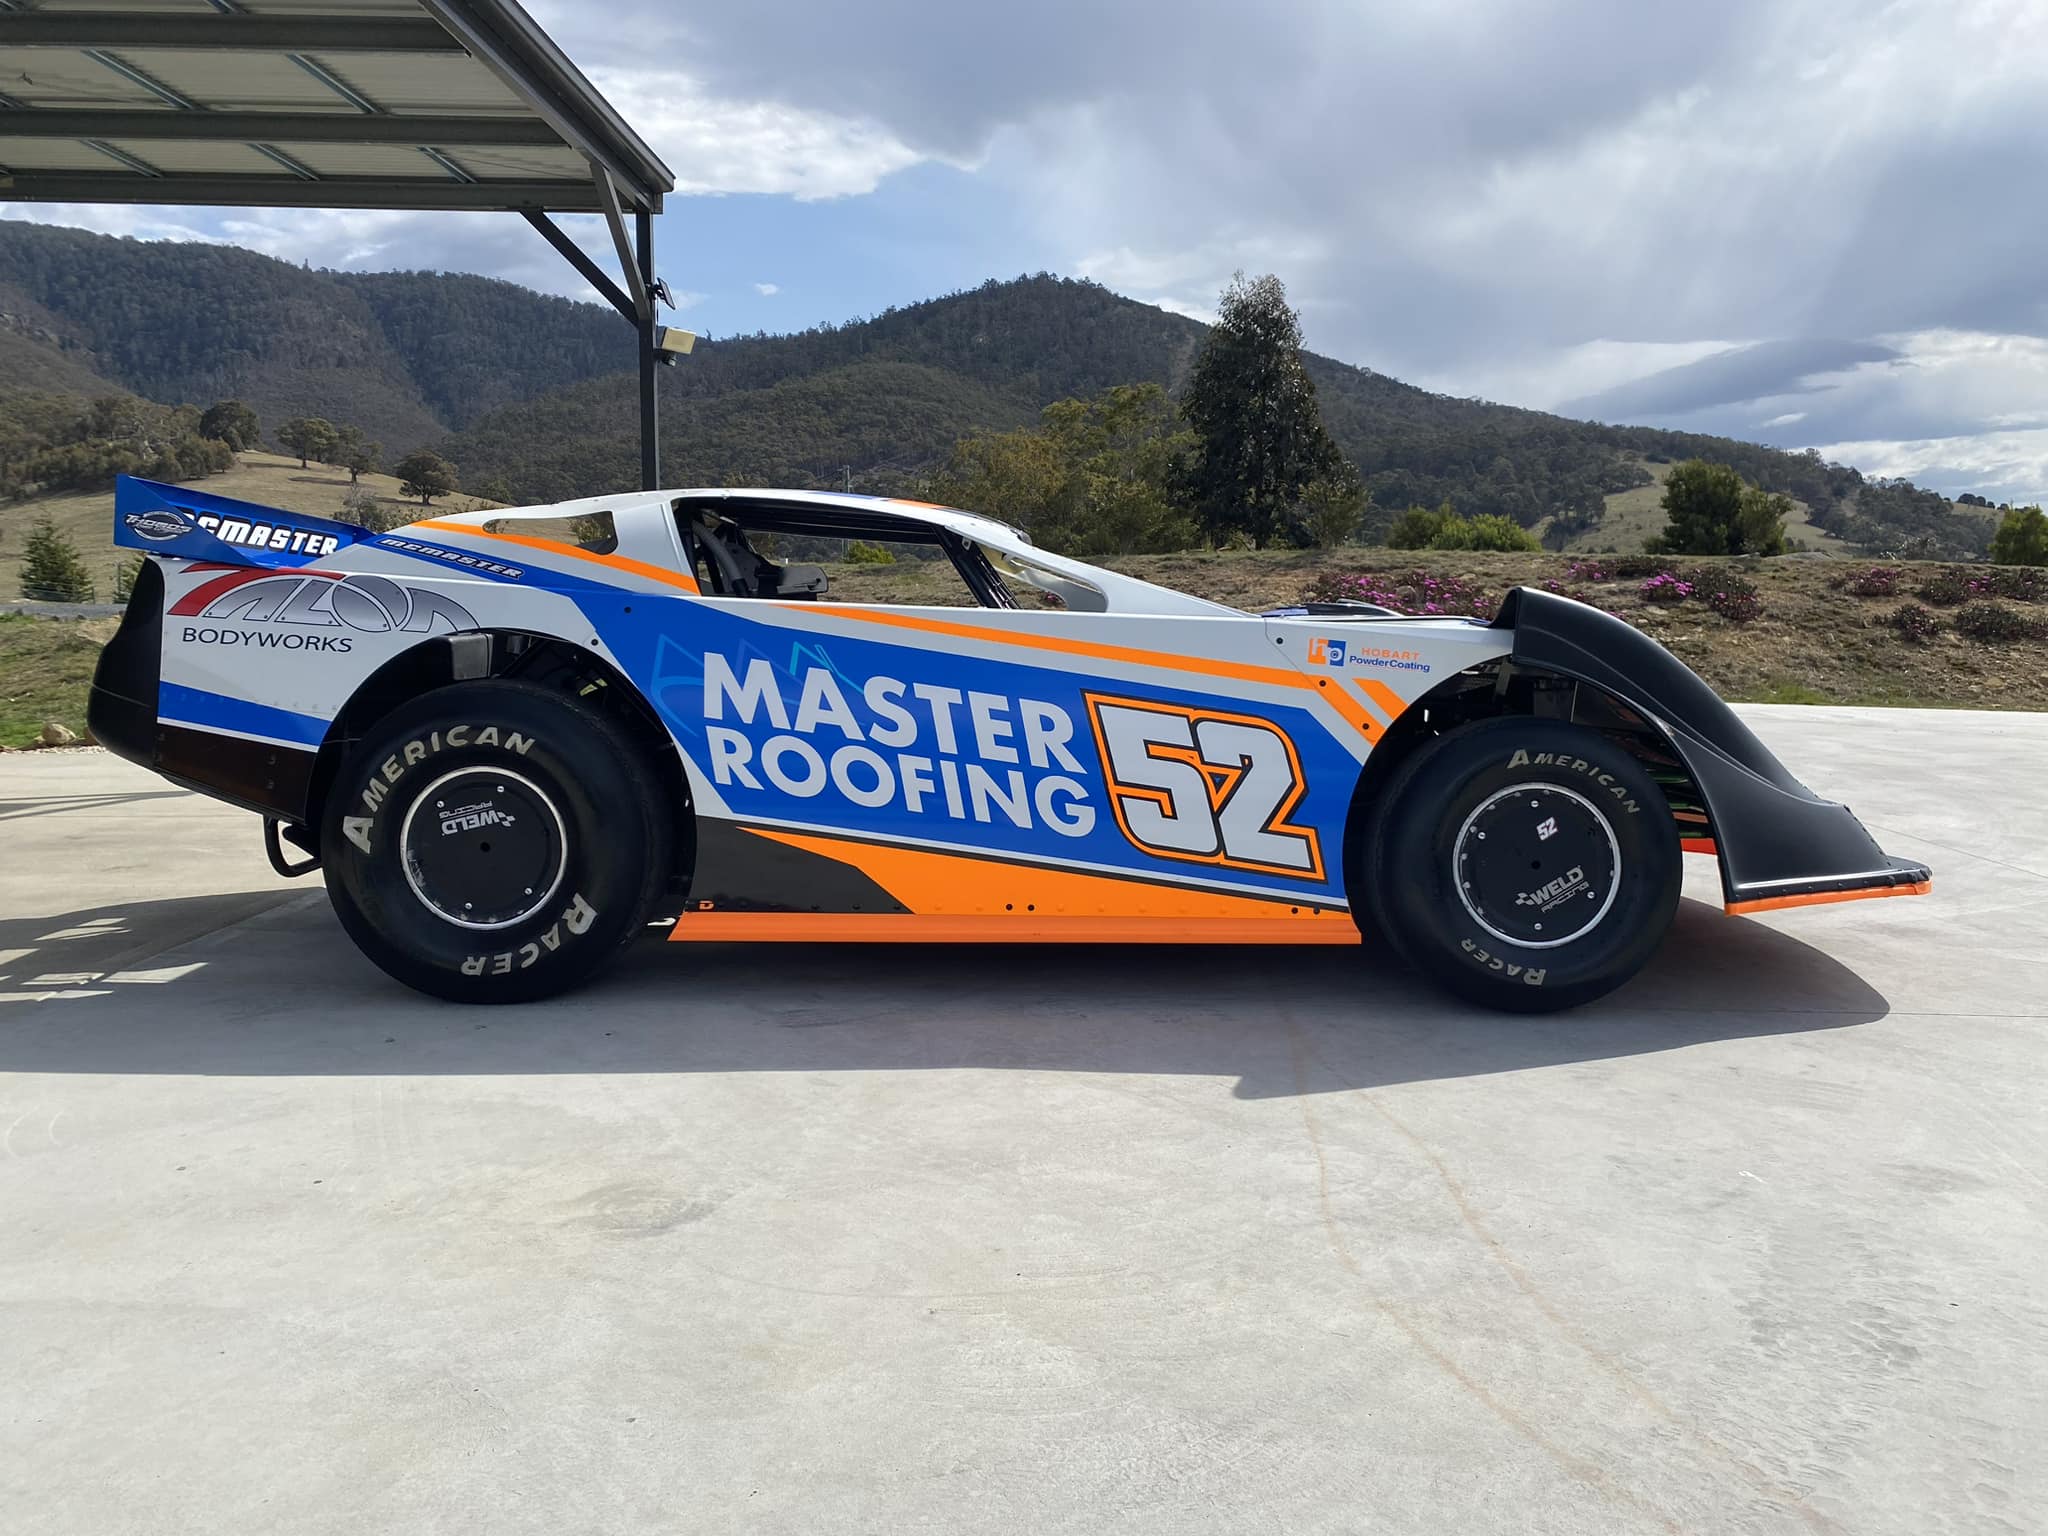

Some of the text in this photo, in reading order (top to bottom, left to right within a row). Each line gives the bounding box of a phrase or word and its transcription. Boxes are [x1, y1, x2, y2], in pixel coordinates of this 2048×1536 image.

[184, 512, 338, 556] CMASTER
[182, 627, 352, 652] BODYWORKS
[1361, 647, 1420, 660] HOBART
[1350, 655, 1430, 673] PowderCoating
[703, 651, 1088, 775] MASTER
[342, 725, 535, 854] AMERICAN
[705, 725, 1096, 838] ROOFING
[1084, 691, 1324, 882] 52
[1507, 749, 1640, 814] AMERICAN
[441, 809, 500, 835] WELD
[1536, 817, 1558, 840] 52
[1529, 866, 1584, 905] WELD
[460, 893, 599, 976] RACER
[1460, 938, 1547, 986] RACER
